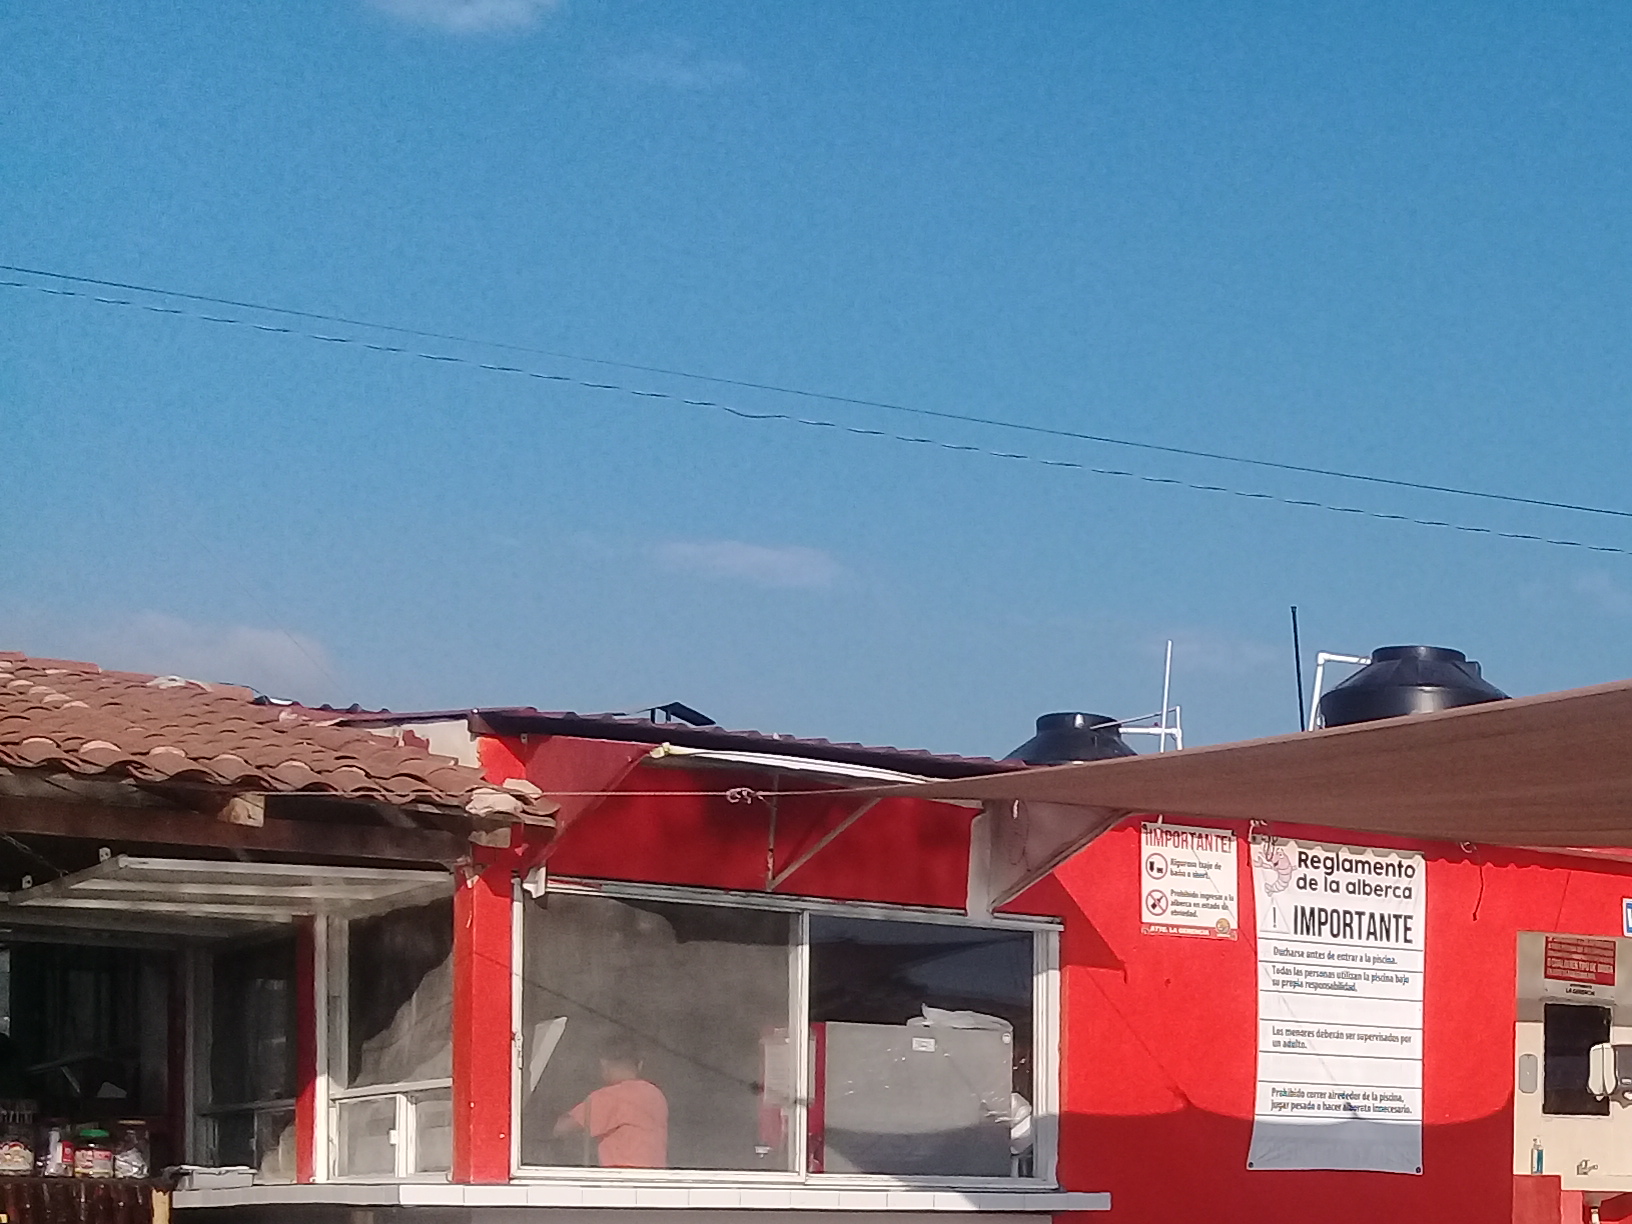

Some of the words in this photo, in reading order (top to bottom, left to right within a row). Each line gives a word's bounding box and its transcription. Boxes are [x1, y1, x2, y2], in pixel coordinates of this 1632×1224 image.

[1298, 851, 1416, 878] Reglamento
[1296, 874, 1318, 891] de
[1325, 876, 1340, 893] la
[1346, 879, 1412, 899] alberca
[1294, 905, 1413, 944] IMPORTANTE
[1273, 946, 1304, 958] Ducharse
[1306, 950, 1325, 959] antes
[1327, 950, 1335, 960] de
[1337, 953, 1358, 962] entrar
[1365, 954, 1371, 963] la
[1373, 954, 1397, 965] piscina.
[1272, 965, 1292, 975] Todas
[1293, 967, 1303, 976] las
[1305, 969, 1335, 979] personas
[1363, 972, 1370, 981] la
[1371, 972, 1393, 983] piscina
[1395, 974, 1409, 985] bajo
[1281, 979, 1303, 989] propia
[1305, 980, 1357, 992] responsabilidad.
[1272, 1026, 1283, 1036] Los
[1285, 1028, 1315, 1038] menores
[1357, 1032, 1399, 1043] supervisados
[1401, 1035, 1411, 1045] por
[1272, 1040, 1281, 1048] un
[1271, 1088, 1305, 1098] Prohibido
[1306, 1091, 1326, 1099] correr
[1328, 1090, 1360, 1100] alrededor
[1362, 1091, 1370, 1101] de
[1372, 1092, 1378, 1101] la
[1291, 1101, 1315, 1112] pesado
[1322, 1102, 1341, 1111] hacer
